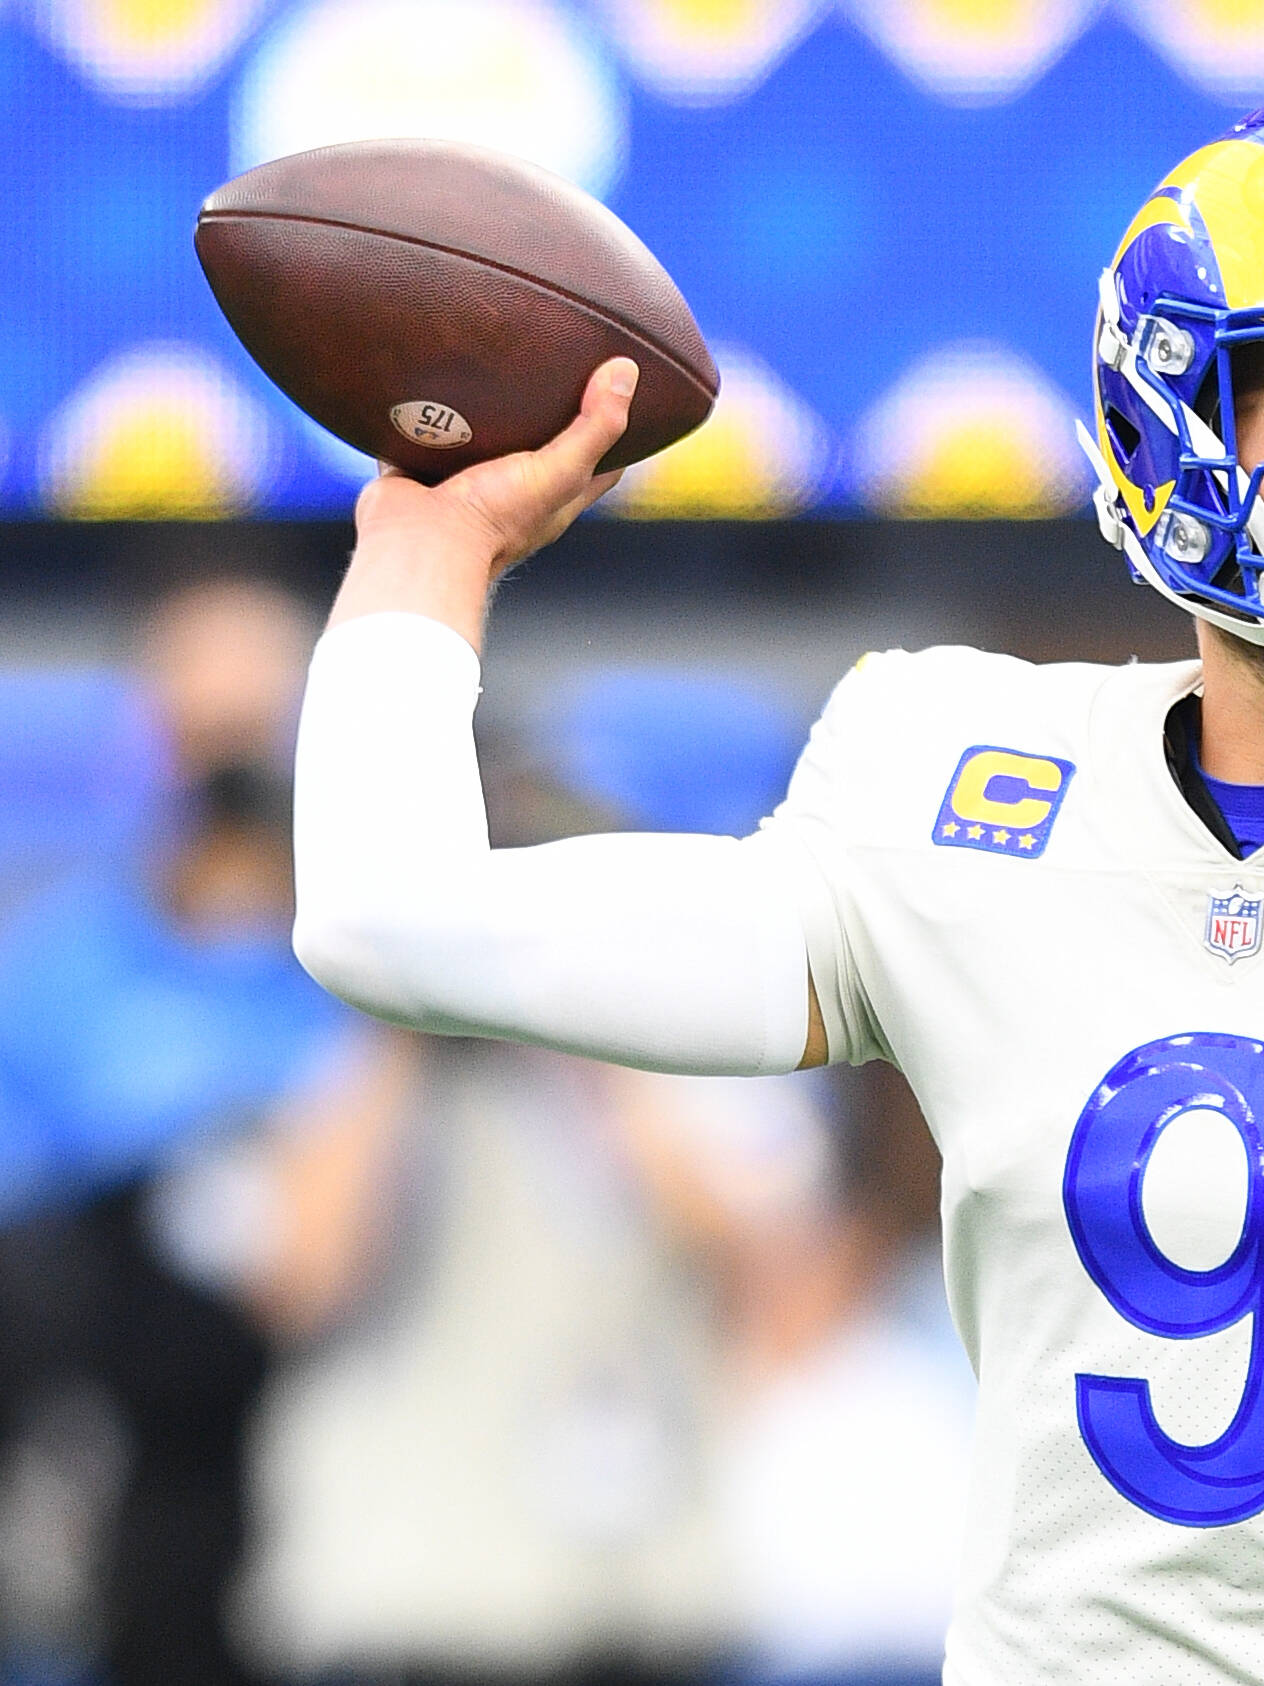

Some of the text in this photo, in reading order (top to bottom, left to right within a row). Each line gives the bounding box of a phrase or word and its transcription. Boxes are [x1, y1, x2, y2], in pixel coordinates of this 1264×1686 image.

[418, 405, 454, 432] 175
[951, 750, 1062, 829] C
[1213, 920, 1252, 949] NFL
